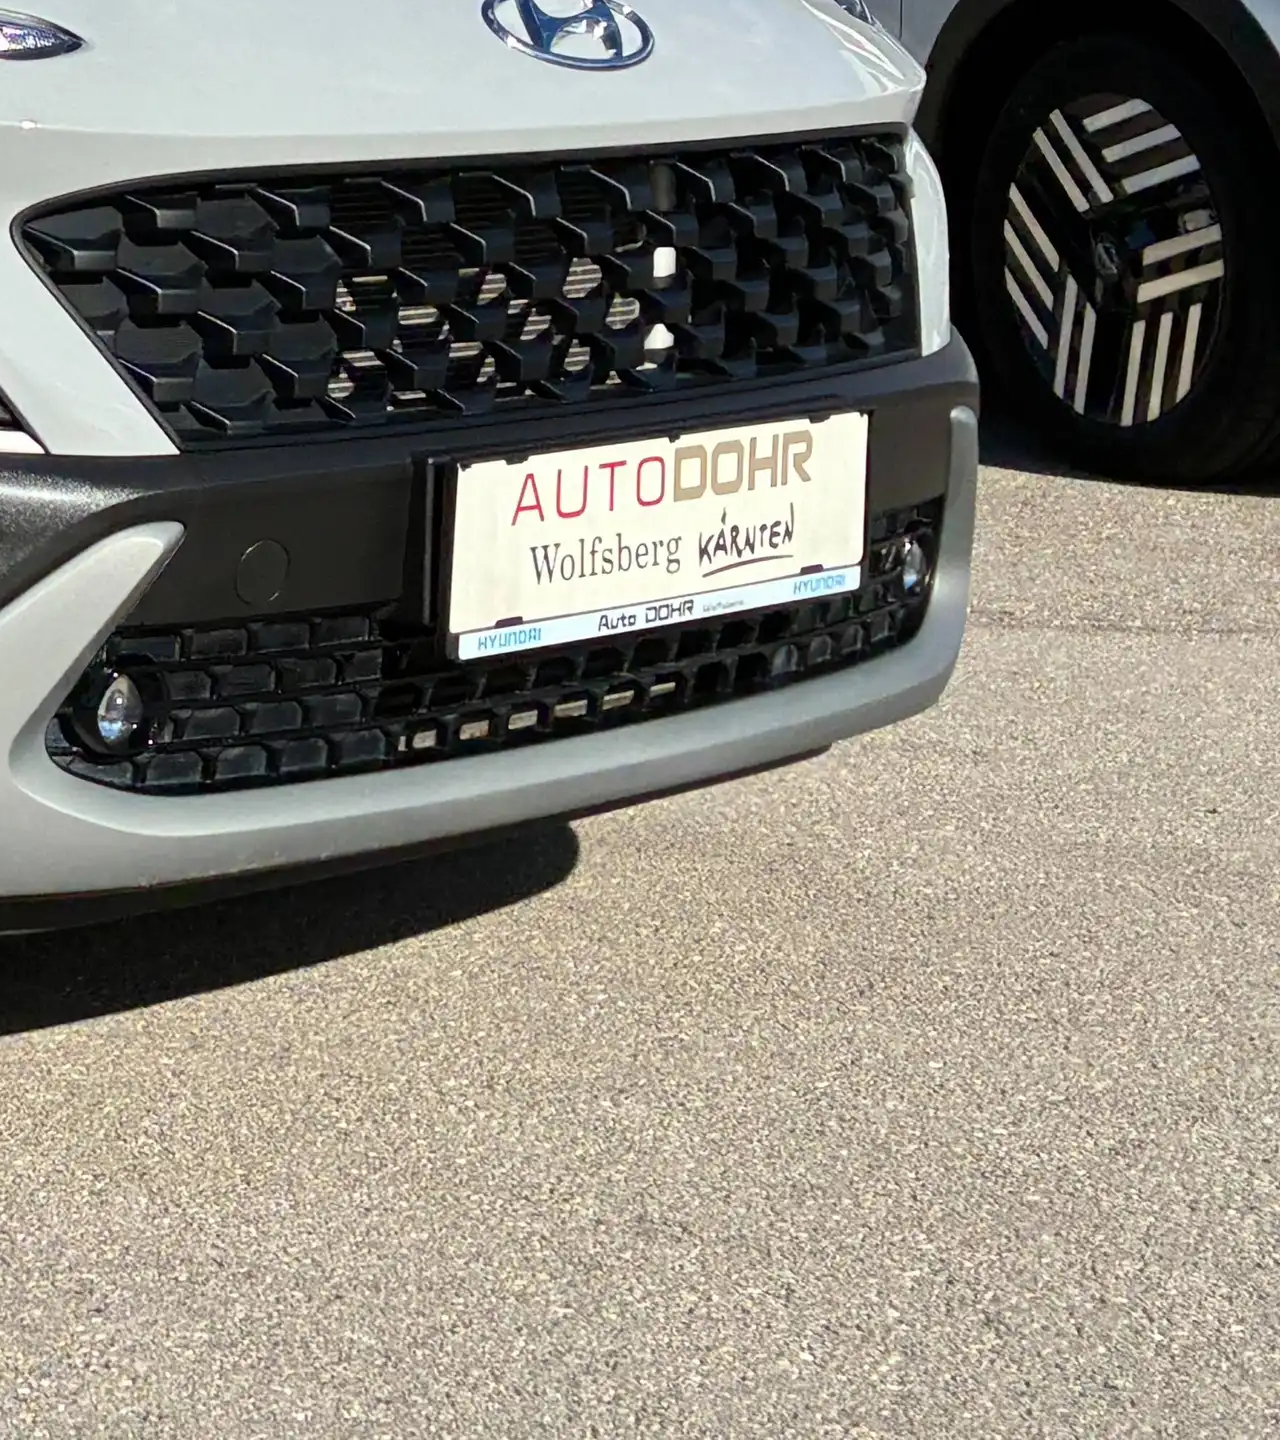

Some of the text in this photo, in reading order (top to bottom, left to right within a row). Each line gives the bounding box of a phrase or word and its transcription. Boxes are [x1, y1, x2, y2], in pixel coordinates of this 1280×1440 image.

[511, 429, 814, 527] AUTODOHR
[529, 532, 683, 585] Wolfsberg
[477, 627, 542, 652] HYUNDAI
[597, 612, 638, 632] Auto
[644, 598, 695, 624] DOHR
